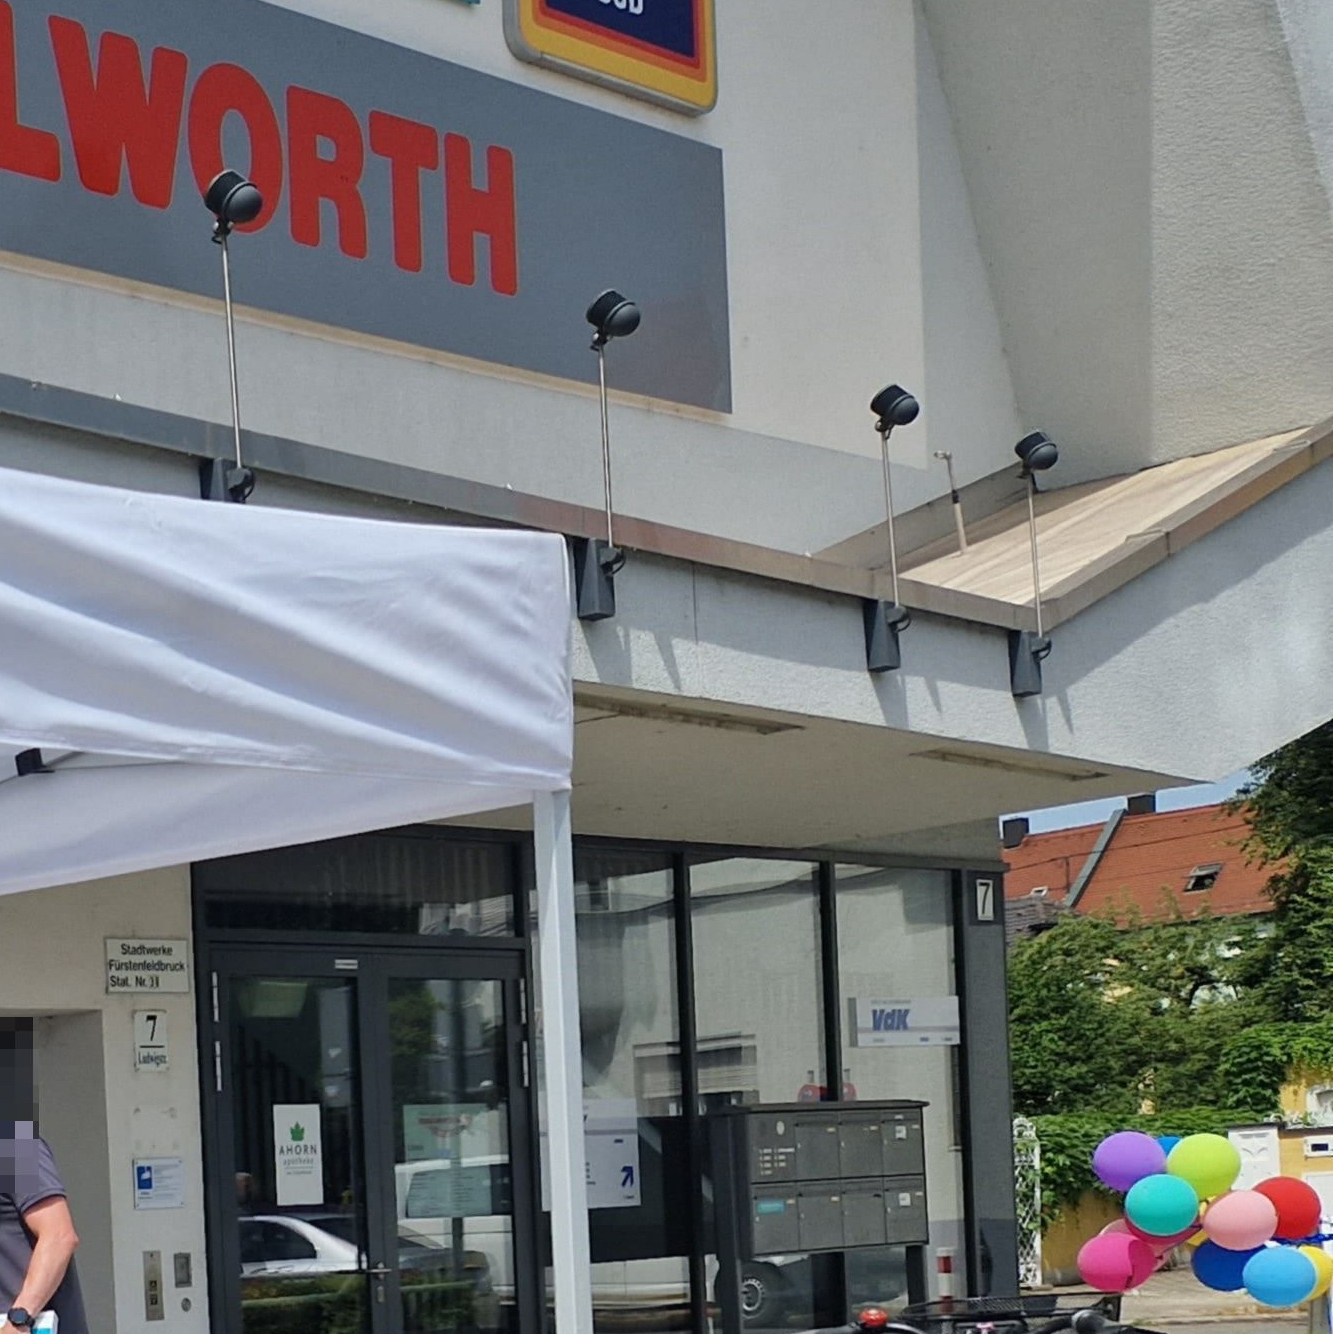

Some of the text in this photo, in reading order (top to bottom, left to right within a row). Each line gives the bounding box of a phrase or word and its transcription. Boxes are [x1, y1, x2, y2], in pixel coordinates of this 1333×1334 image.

[978, 882, 993, 914] 7
[120, 943, 173, 956] Stadtwerke
[145, 1014, 158, 1041] 7
[872, 1008, 910, 1031] VdK
[278, 1144, 318, 1155] AHORN
